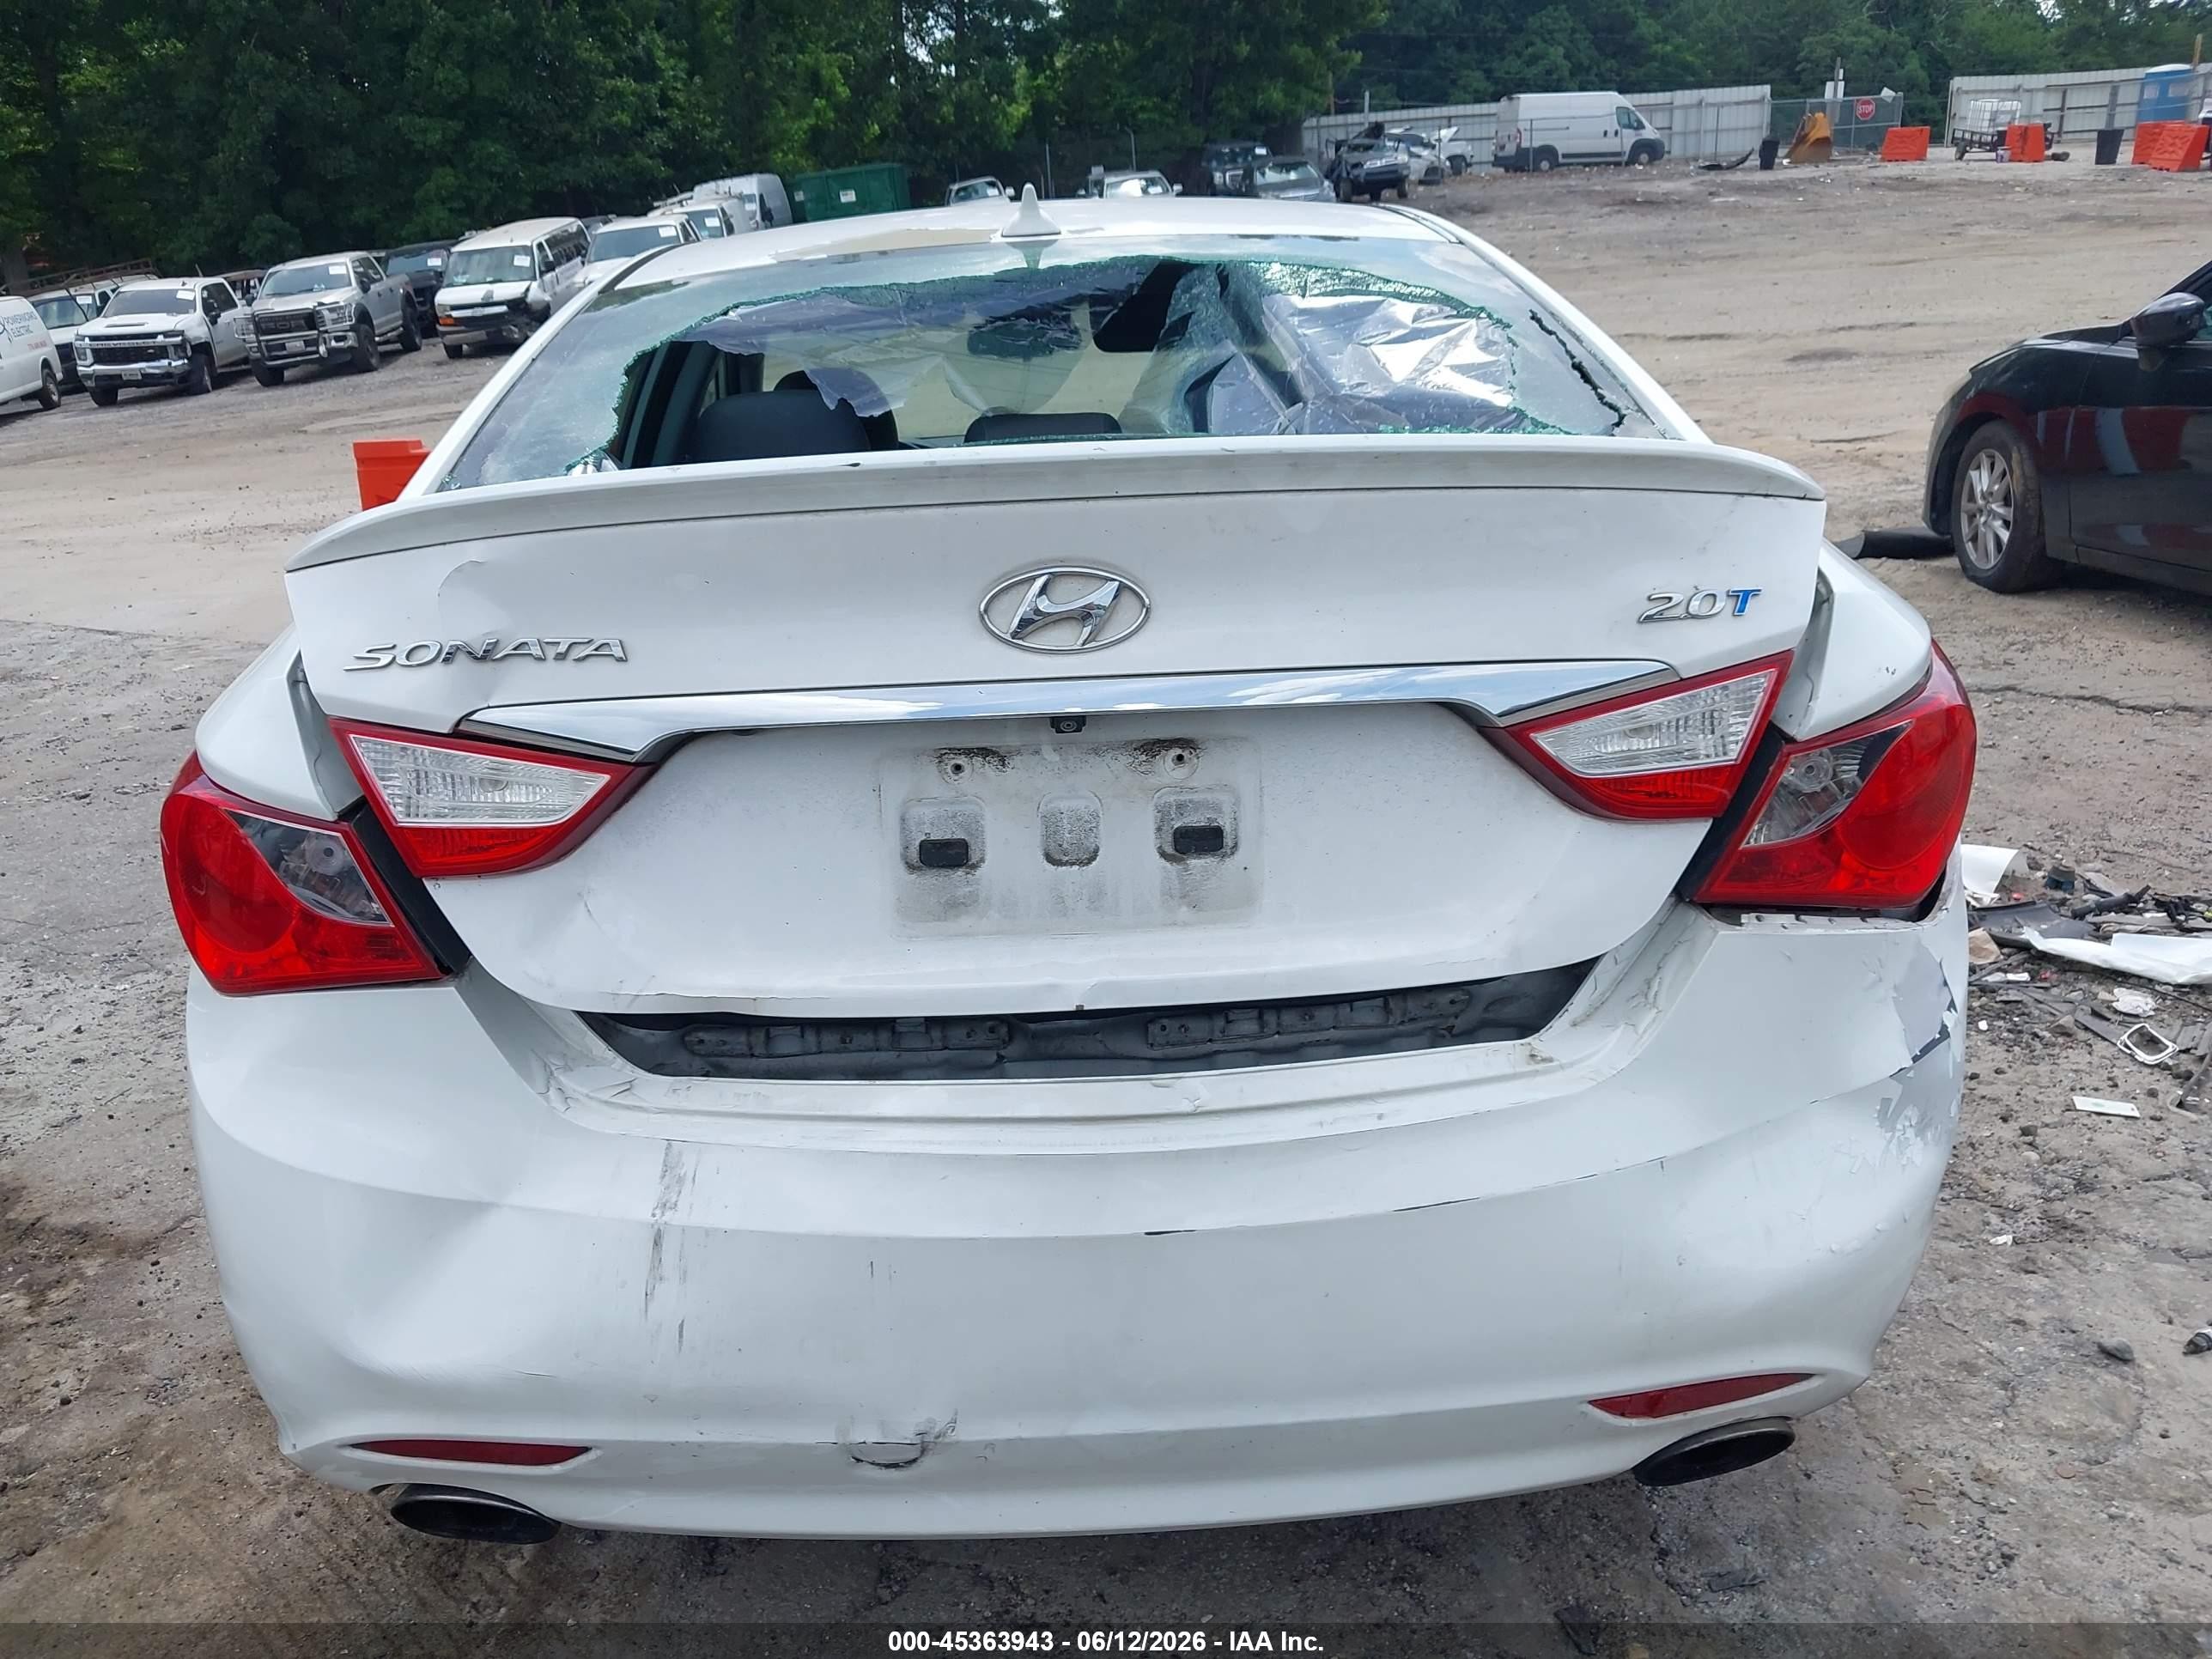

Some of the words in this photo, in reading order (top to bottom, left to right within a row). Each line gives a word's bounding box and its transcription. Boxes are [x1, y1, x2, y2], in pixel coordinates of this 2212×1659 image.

[1858, 104, 1874, 113] STOP
[1637, 587, 1763, 623] 2.0T
[343, 638, 629, 672] SONATA
